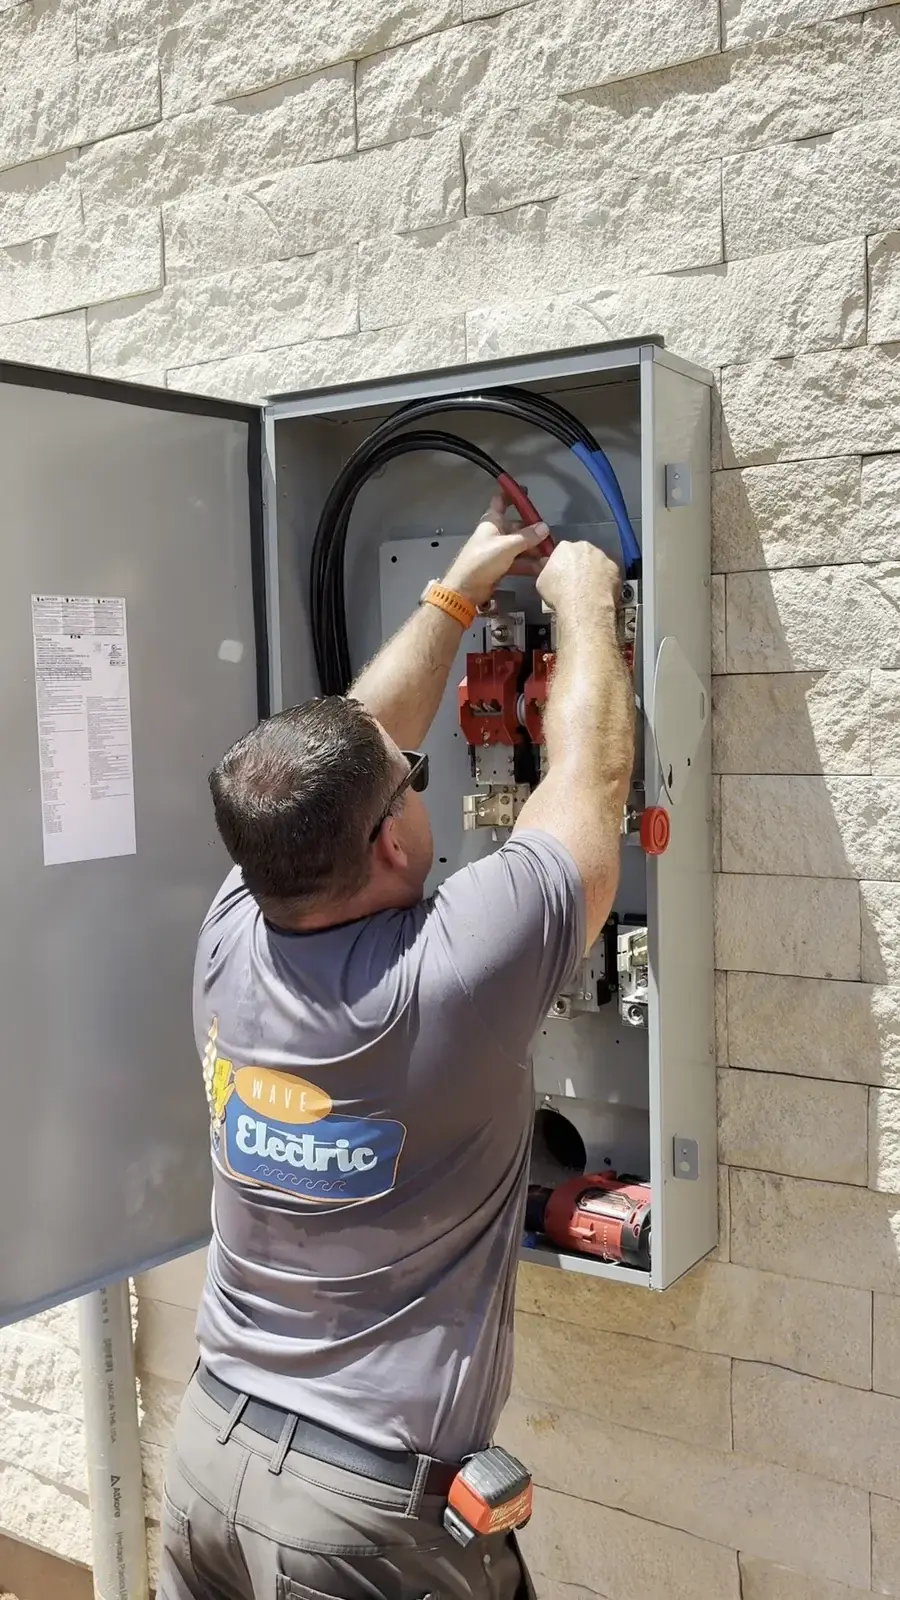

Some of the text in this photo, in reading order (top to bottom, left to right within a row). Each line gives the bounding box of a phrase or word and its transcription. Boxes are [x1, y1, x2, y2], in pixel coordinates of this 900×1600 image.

[252, 1078, 307, 1112] WAVE
[236, 1114, 378, 1172] Electric
[113, 1487, 122, 1517] Atkore
